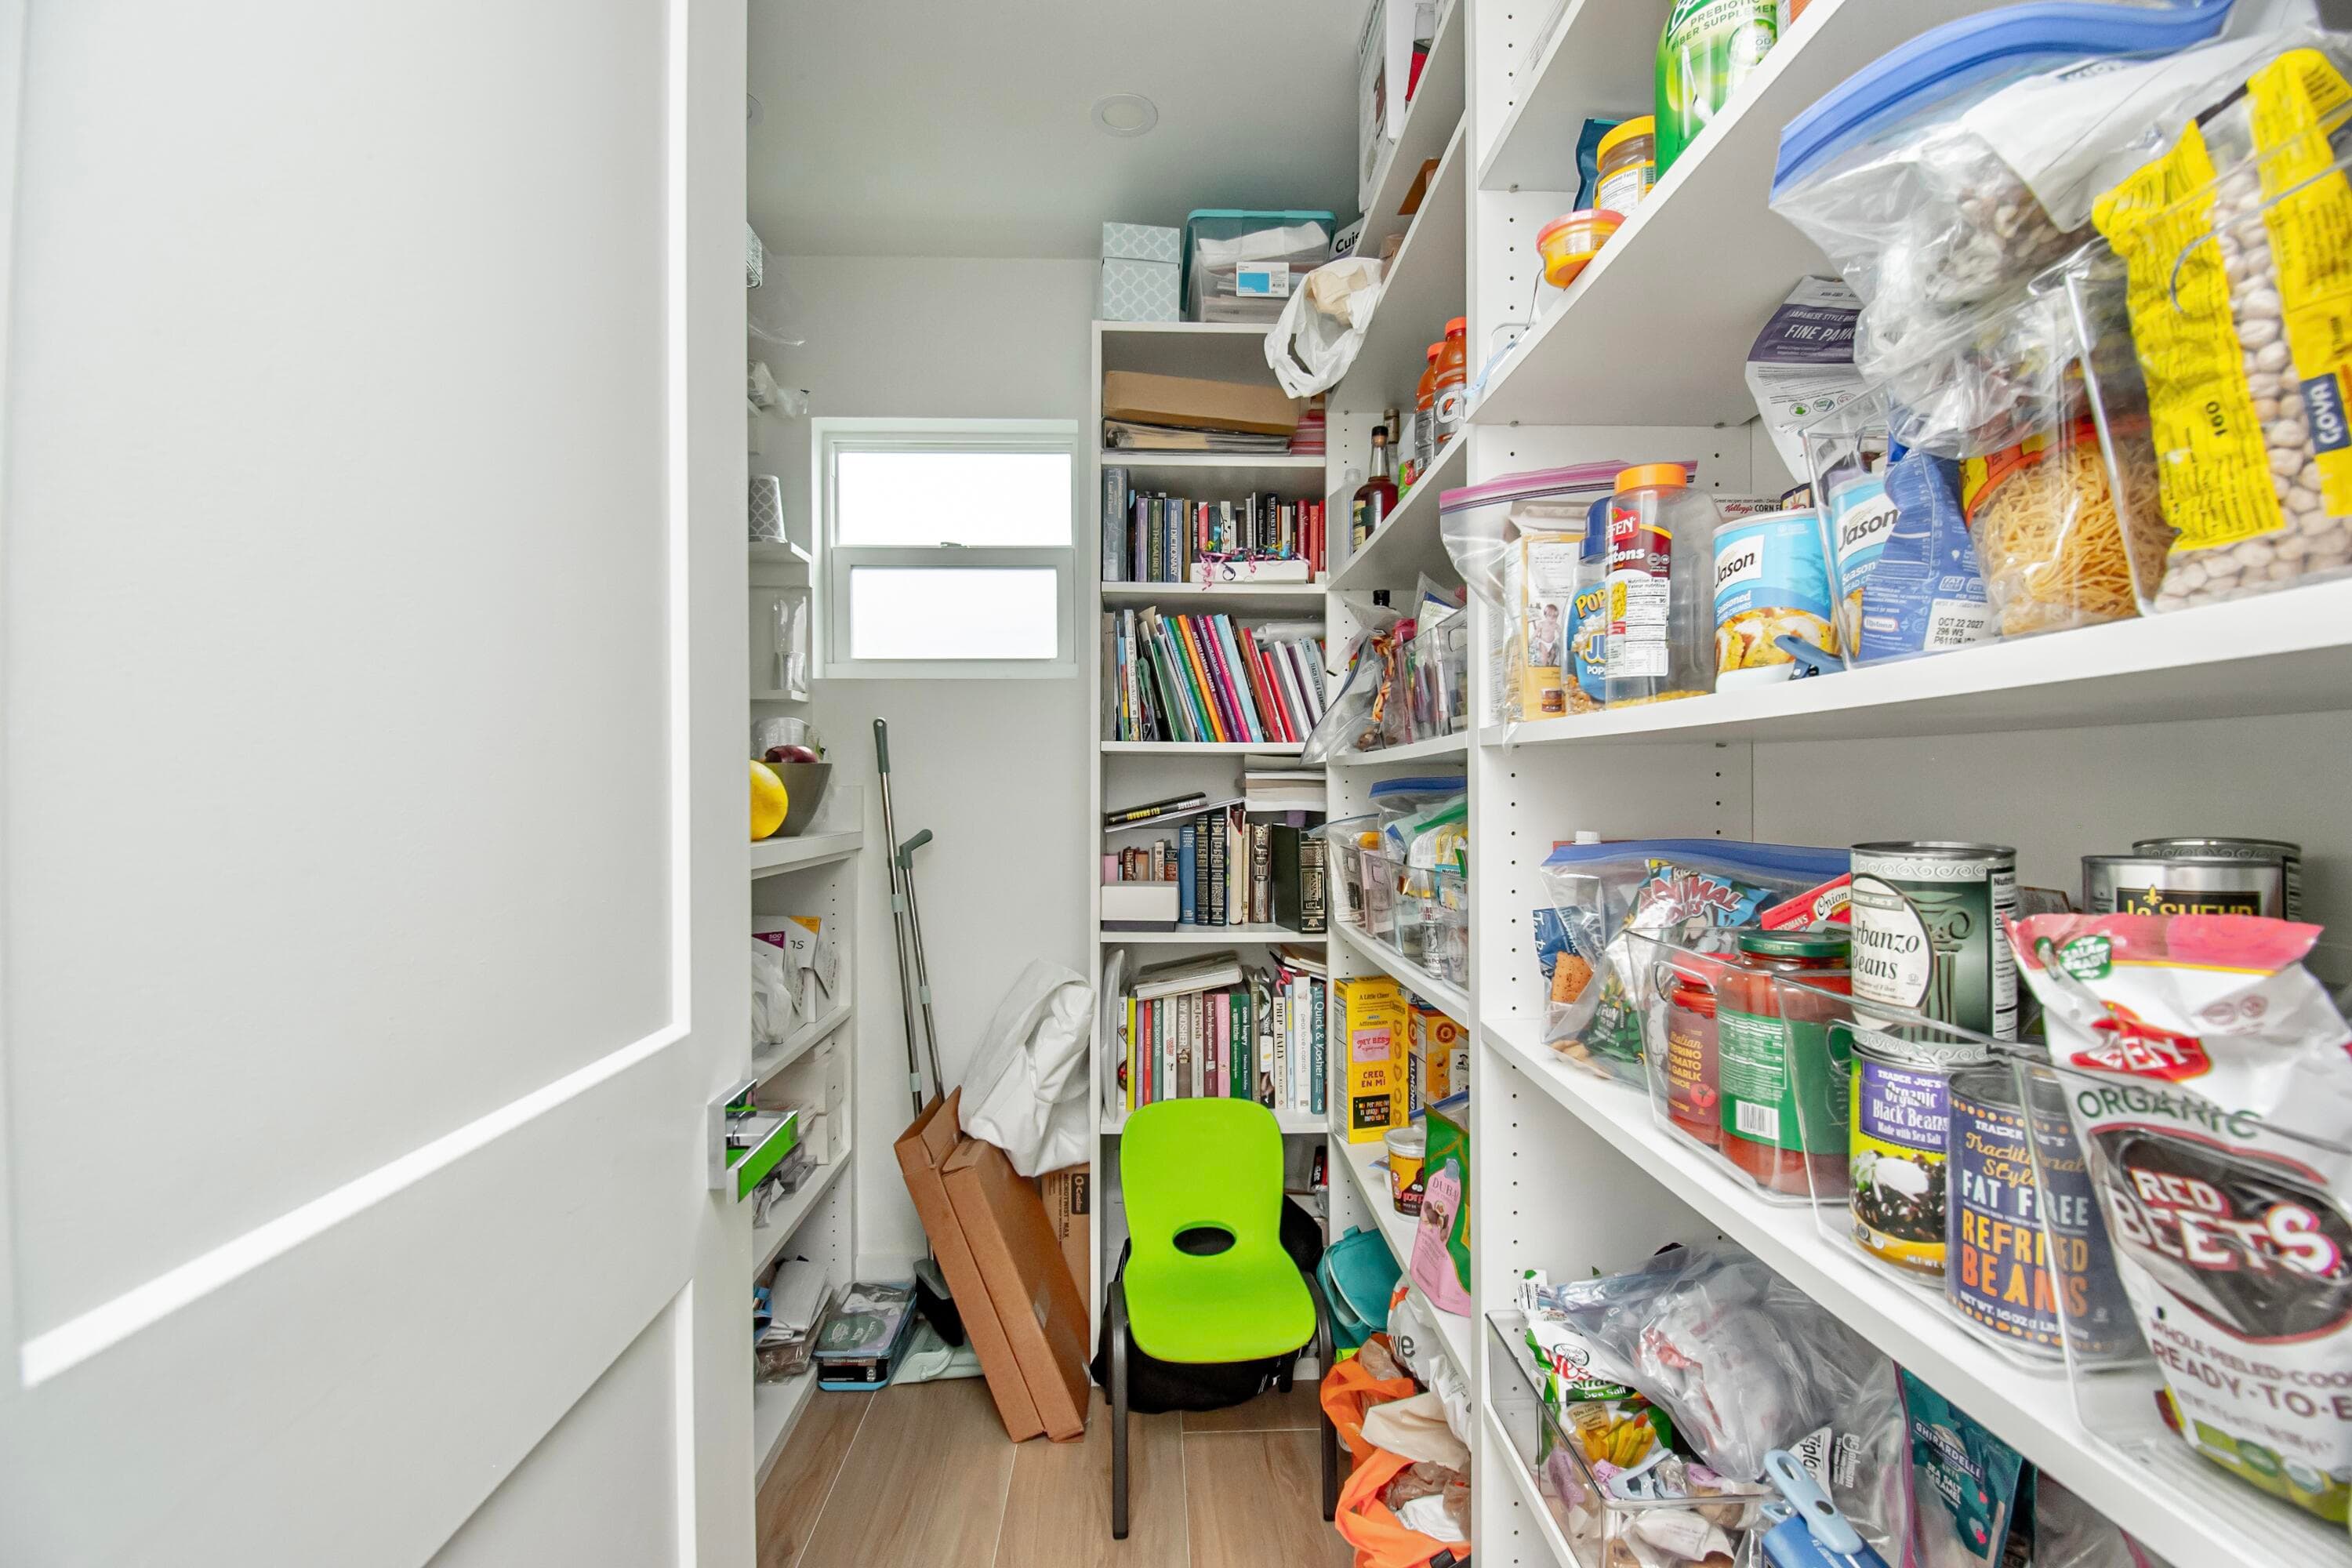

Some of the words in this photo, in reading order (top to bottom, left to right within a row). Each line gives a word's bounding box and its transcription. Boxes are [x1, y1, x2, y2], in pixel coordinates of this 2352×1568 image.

[1671, 27, 1700, 52] FIBER
[1789, 310, 1822, 322] JAPANESE
[1823, 312, 1843, 322] STYLE
[1784, 324, 1820, 340] FINE
[1821, 327, 1856, 343] PANK
[1725, 503, 1754, 514] Kellogg's
[1838, 509, 1898, 553] Jason
[1715, 552, 1755, 588] Jason
[1938, 617, 1954, 626] OCT
[1956, 618, 1965, 626] 22
[1967, 619, 1984, 629] 2027
[1195, 639, 1203, 654] FIRST
[1199, 652, 1210, 673] PARSHA
[1205, 673, 1216, 692] READER
[1316, 691, 1327, 713] CHAMPION
[1638, 876, 1743, 913] ANIMAL
[1817, 891, 1848, 916] Onion
[1852, 945, 1898, 980] Beans
[1193, 1010, 1202, 1040] Jewish
[1314, 1001, 1325, 1029] Quick
[1179, 1014, 1188, 1046] KOSHER
[1241, 1025, 1250, 1046] hungry
[1315, 1032, 1324, 1041] &
[1357, 1038, 1371, 1049] MY
[1372, 1036, 1391, 1046] BEST
[1670, 1030, 1703, 1049] Italian
[1313, 1044, 1324, 1077] Kosher
[1672, 1065, 1702, 1082] GARLIC
[1363, 1070, 1384, 1079] CREO
[1877, 1069, 1911, 1084] TRADER
[1914, 1077, 1942, 1088] JOE'S
[1885, 1080, 1938, 1109] Organic
[1873, 1098, 1904, 1125] Black
[1907, 1107, 1949, 1131] Beans
[2077, 1085, 2263, 1138] ORGANIC
[1877, 1120, 1895, 1135] Made
[1896, 1127, 1911, 1140] with
[1912, 1129, 1926, 1142] Sea
[1926, 1132, 1942, 1145] Salt
[1975, 1120, 2024, 1141] TRADER
[1075, 1176, 1084, 1213] O-Cedar
[1962, 1169, 2001, 1208] FAT
[2017, 1187, 2089, 1226] FREE
[2129, 1167, 2223, 1213] RED
[2106, 1186, 2338, 1277] BEETS
[1960, 1290, 1976, 1307] NET
[1584, 1390, 1604, 1399] Sea
[1606, 1385, 1627, 1397] Salt
[1915, 1421, 1981, 1479] GHIRARDELLI
[1926, 1461, 1941, 1479] SEA
[1943, 1475, 1962, 1494] SALT
